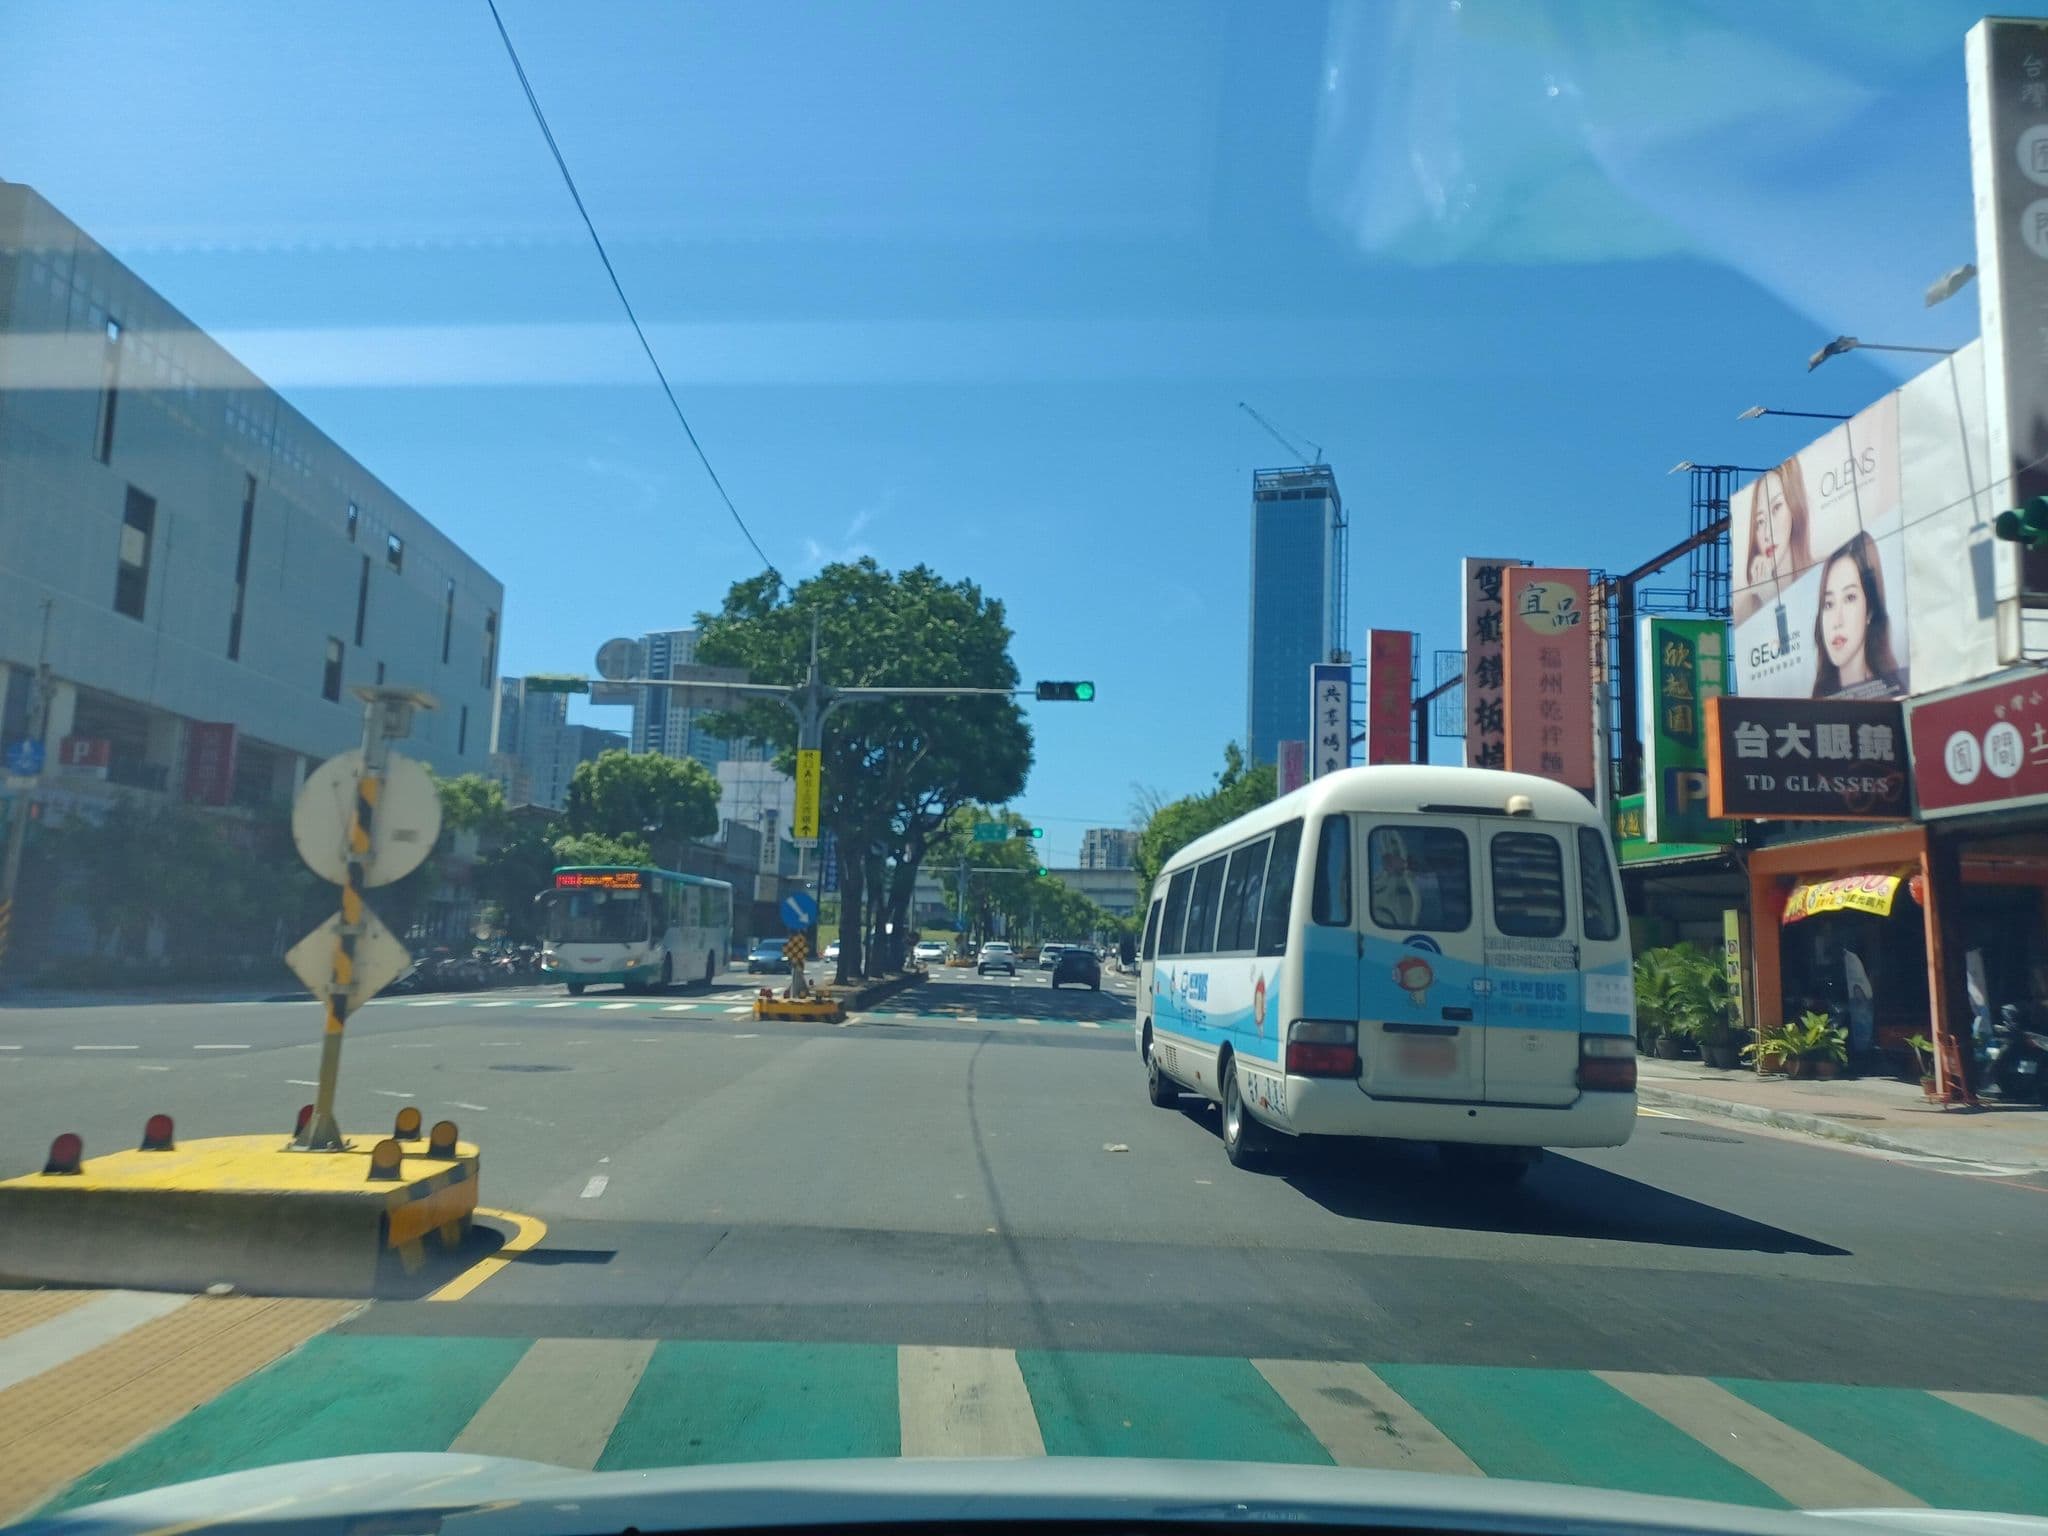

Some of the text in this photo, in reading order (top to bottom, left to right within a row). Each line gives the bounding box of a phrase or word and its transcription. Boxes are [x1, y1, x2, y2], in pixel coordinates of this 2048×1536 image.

[1821, 446, 1876, 497] OLENS
[1518, 583, 1582, 628] 宜品
[1735, 720, 1895, 761] 台大眼鏡
[1744, 775, 1889, 793] TD GLASSES
